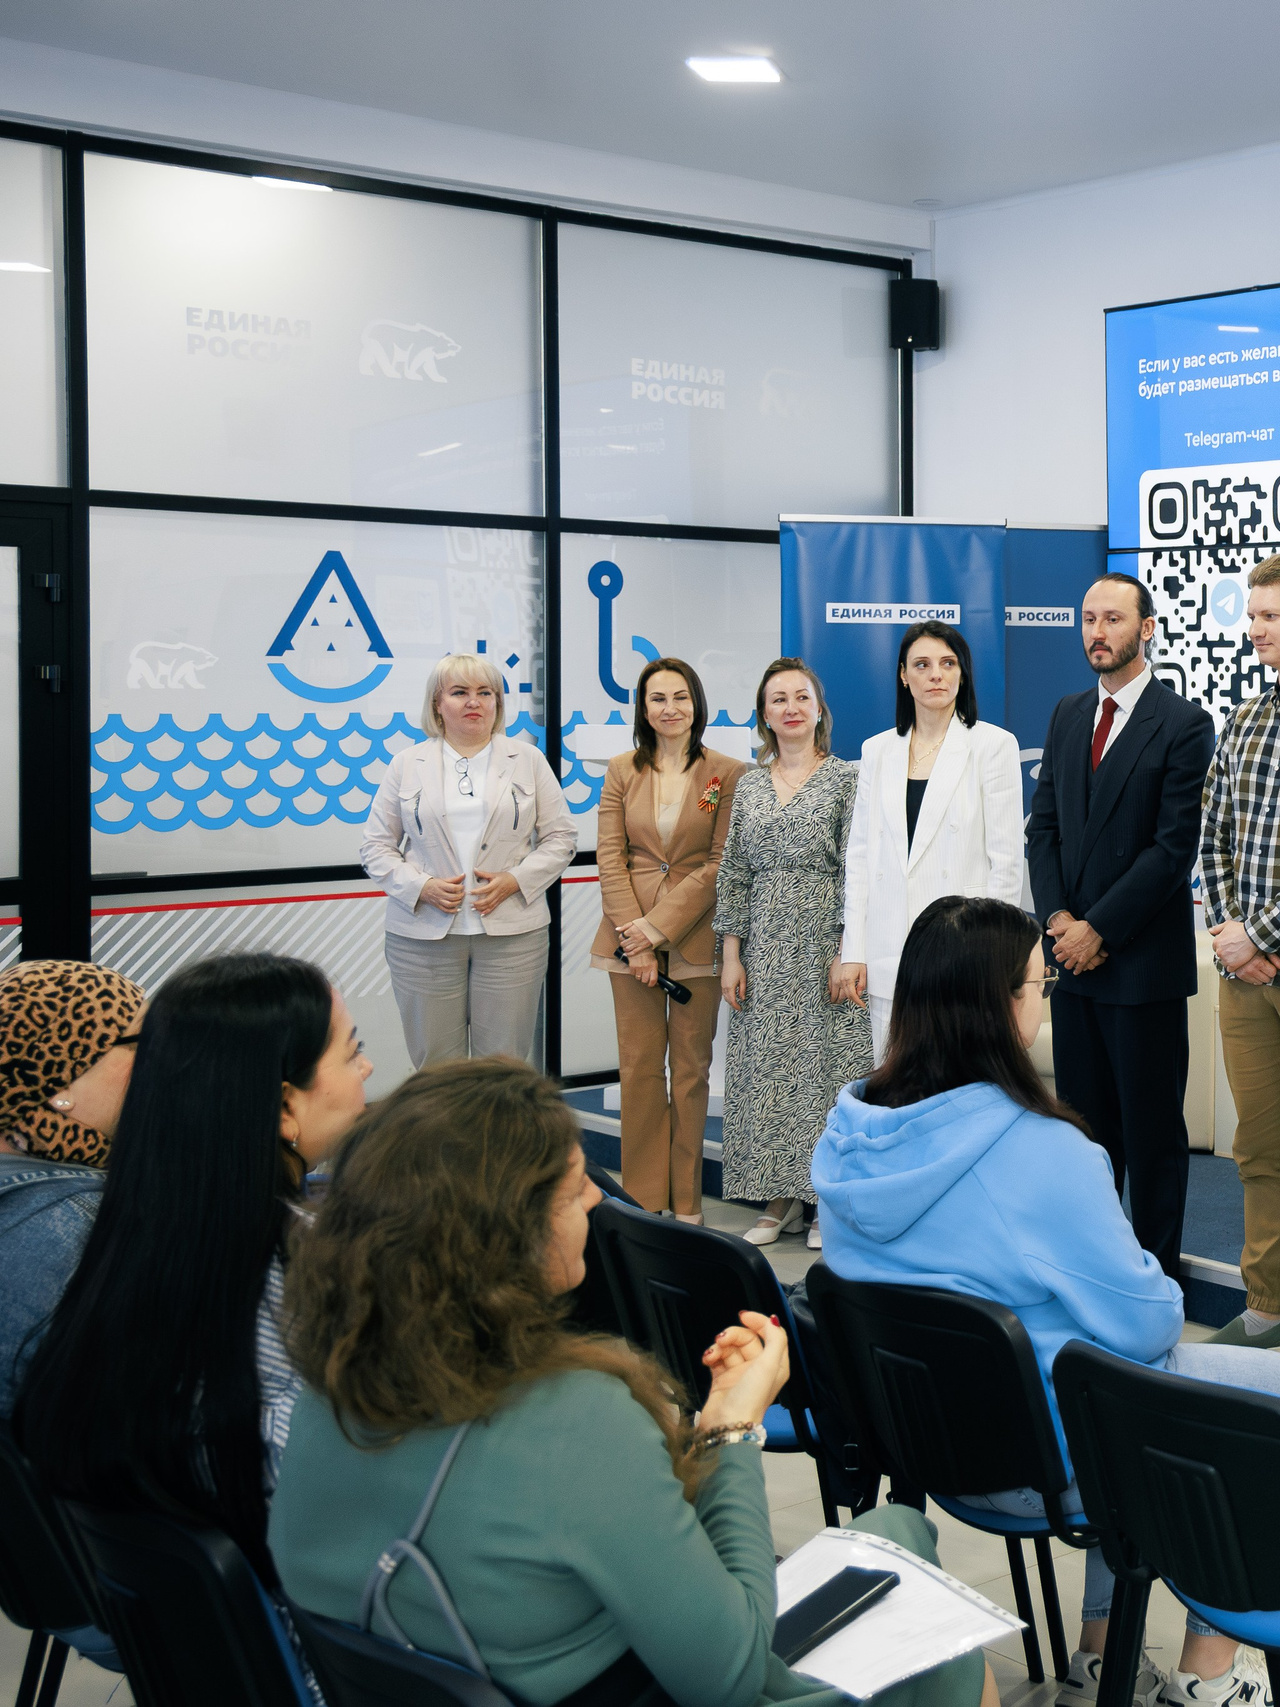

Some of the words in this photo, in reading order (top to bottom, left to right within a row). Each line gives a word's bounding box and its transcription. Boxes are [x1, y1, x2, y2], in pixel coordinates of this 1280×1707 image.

[185, 306, 312, 339] ЕДИНАЯ
[186, 333, 308, 365] РОССИ
[1138, 358, 1170, 374] Если
[1172, 357, 1181, 374] у
[1183, 354, 1206, 369] вас
[1208, 350, 1239, 366] есть
[631, 357, 726, 386] ЕДИНАЯ
[1138, 379, 1177, 400] будет
[1178, 370, 1269, 396] размещаться
[631, 381, 726, 410] РОССИЯ
[1184, 427, 1275, 449] Telegram-чат
[831, 608, 892, 619] ЕДИНАЯ
[899, 608, 955, 619] РОССИЯ
[1018, 612, 1070, 622] РОССИЯ
